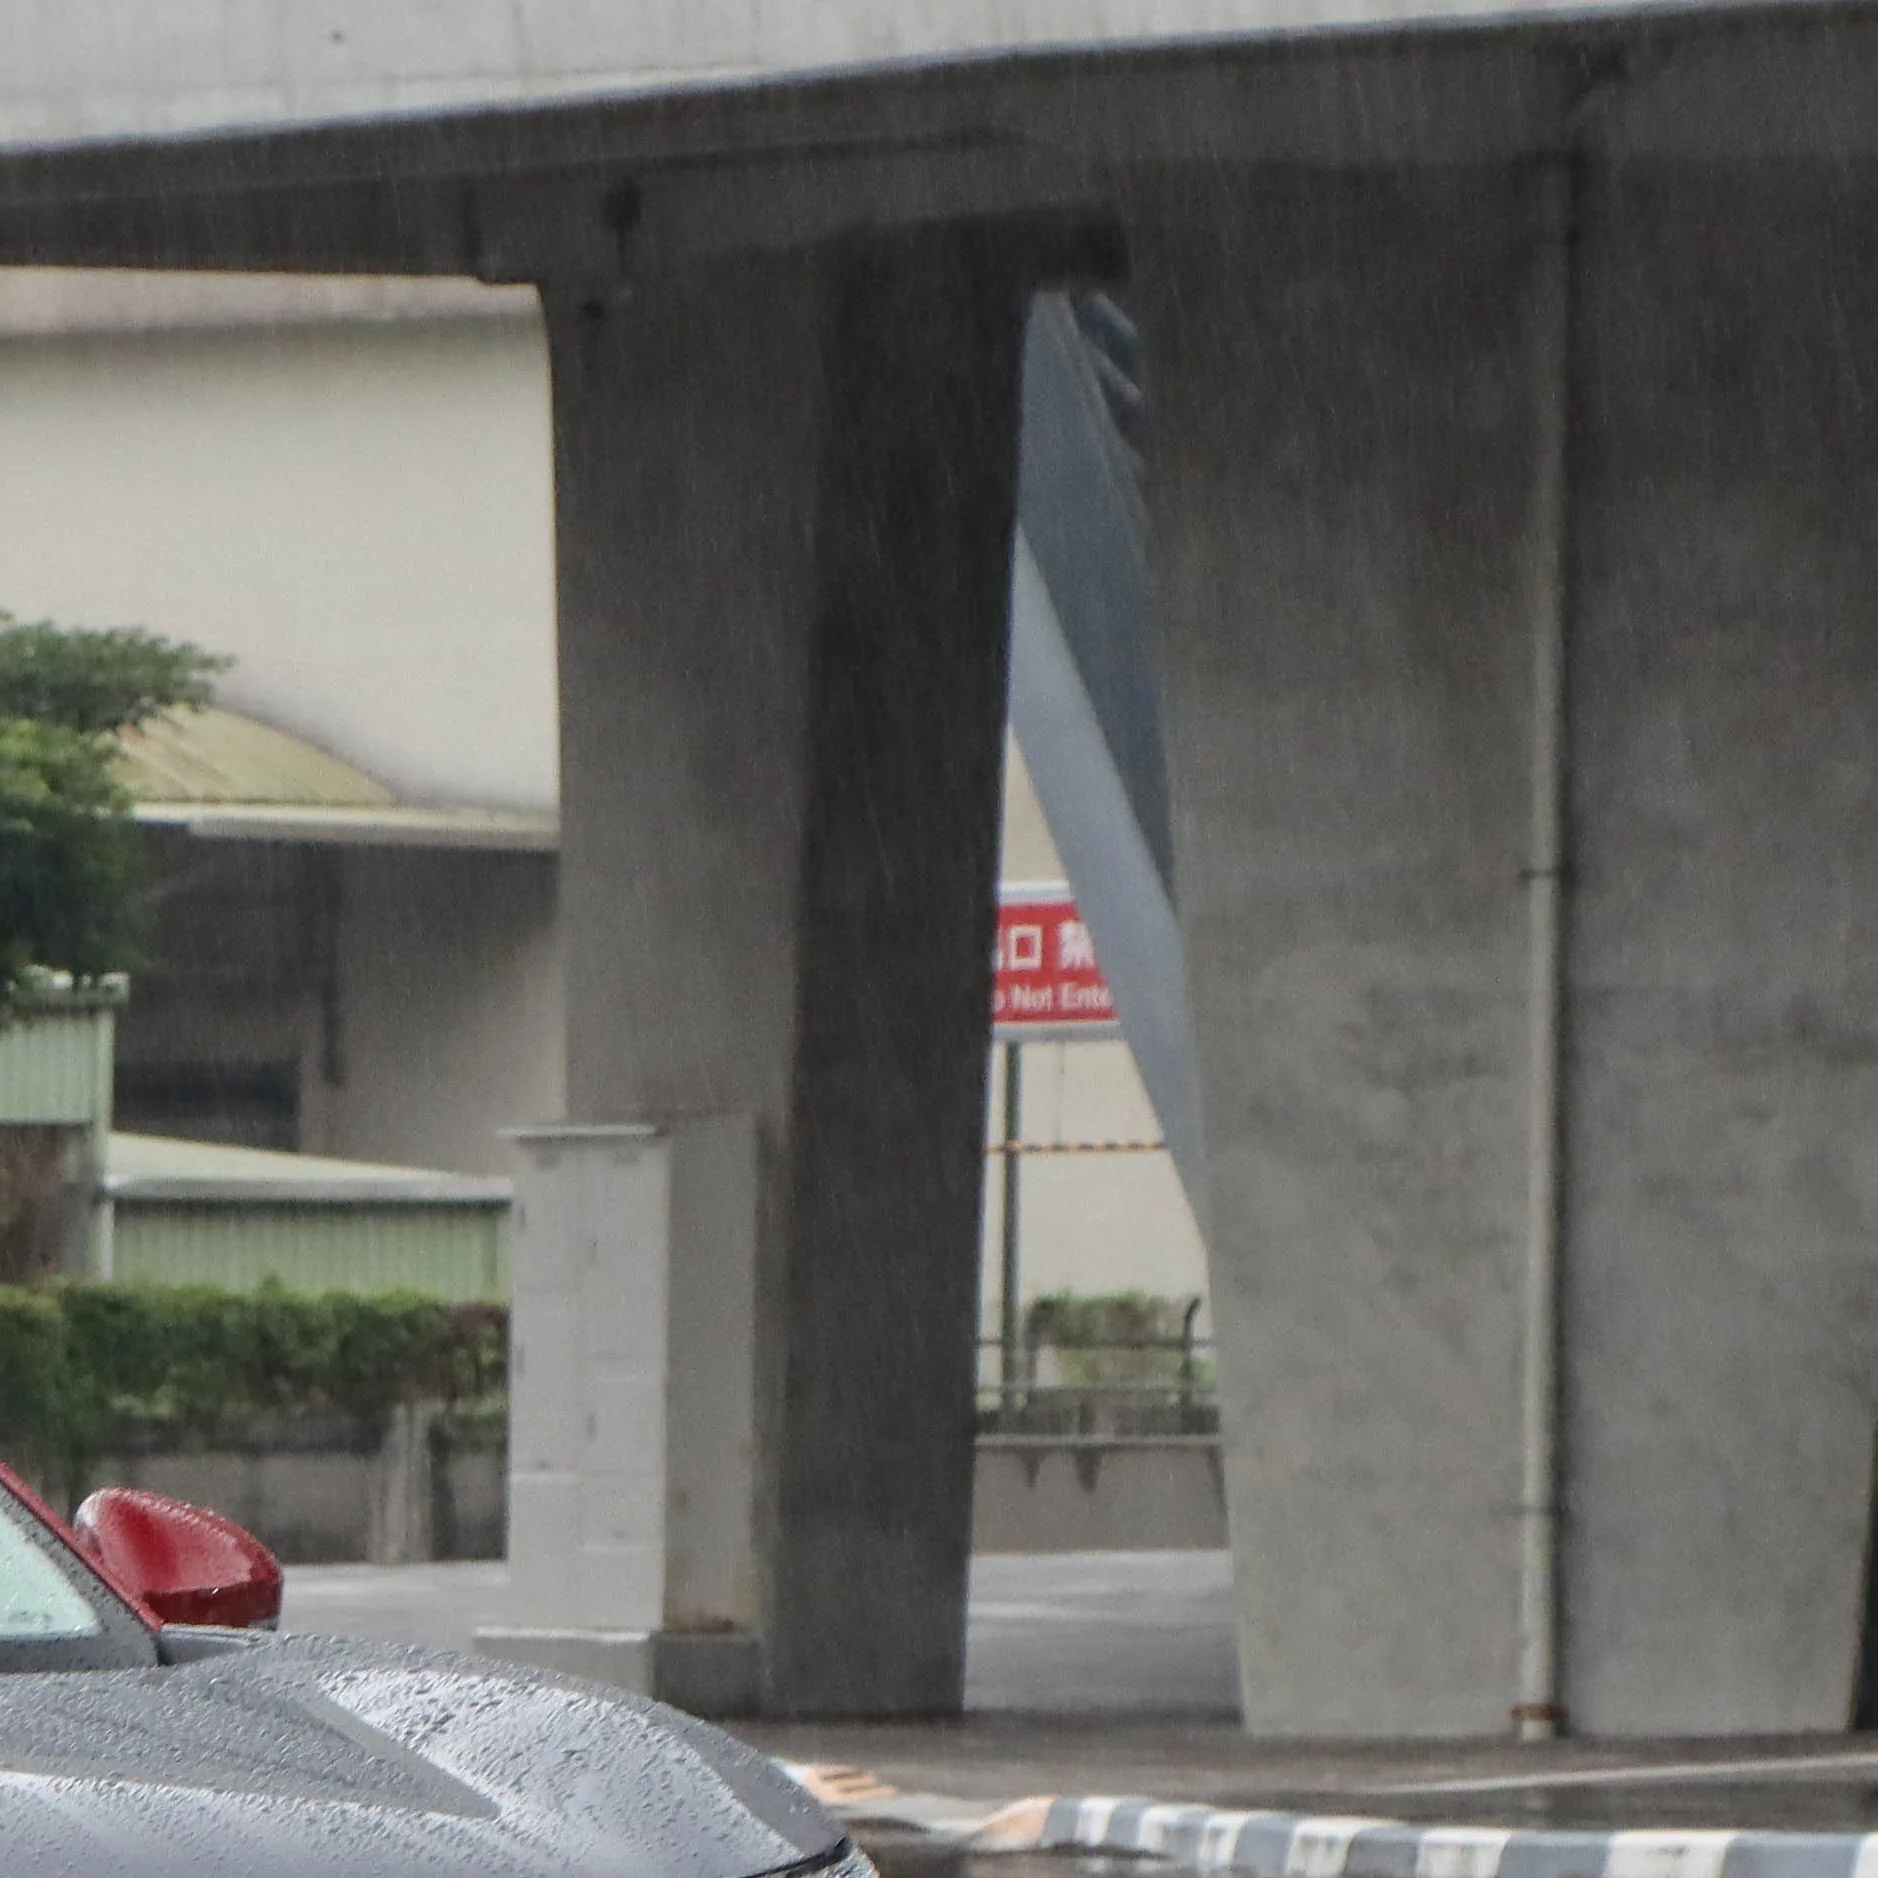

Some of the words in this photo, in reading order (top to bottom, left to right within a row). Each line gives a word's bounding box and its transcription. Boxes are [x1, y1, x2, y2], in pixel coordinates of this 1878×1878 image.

[992, 924, 1042, 970] 口
[1011, 983, 1051, 1012] Not
[1059, 981, 1114, 1010] Ente
